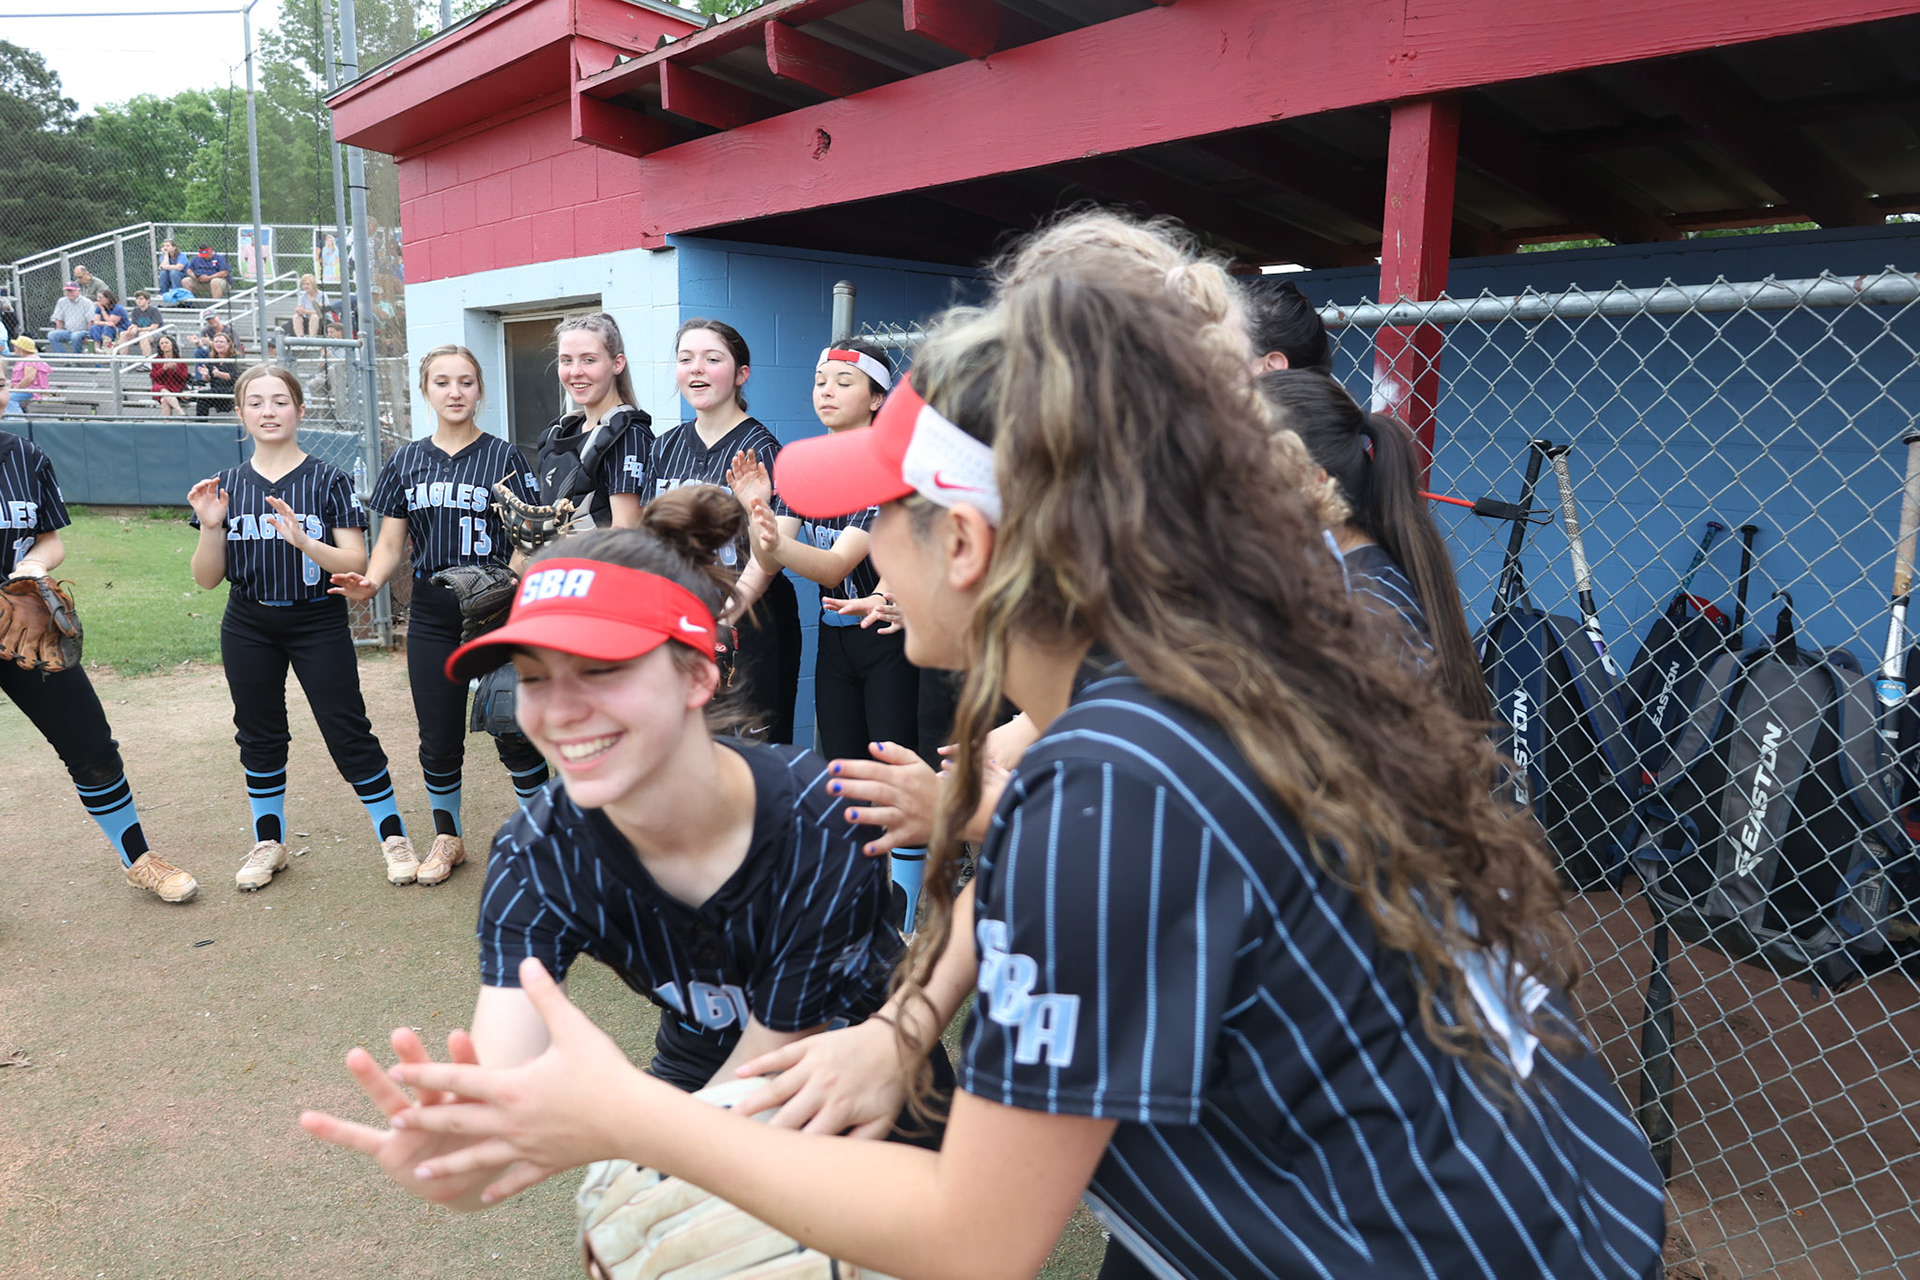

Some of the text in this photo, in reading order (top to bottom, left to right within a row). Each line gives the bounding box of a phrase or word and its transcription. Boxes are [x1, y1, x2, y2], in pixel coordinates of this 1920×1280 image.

[623, 455, 645, 486] SB
[405, 481, 489, 513] EAGLES
[227, 513, 323, 541] EAGS
[459, 516, 492, 556] 13
[519, 568, 596, 607] SBA
[1513, 688, 1529, 805] EASTON
[1741, 721, 1783, 852] EASTON
[976, 918, 1081, 1069] SBA
